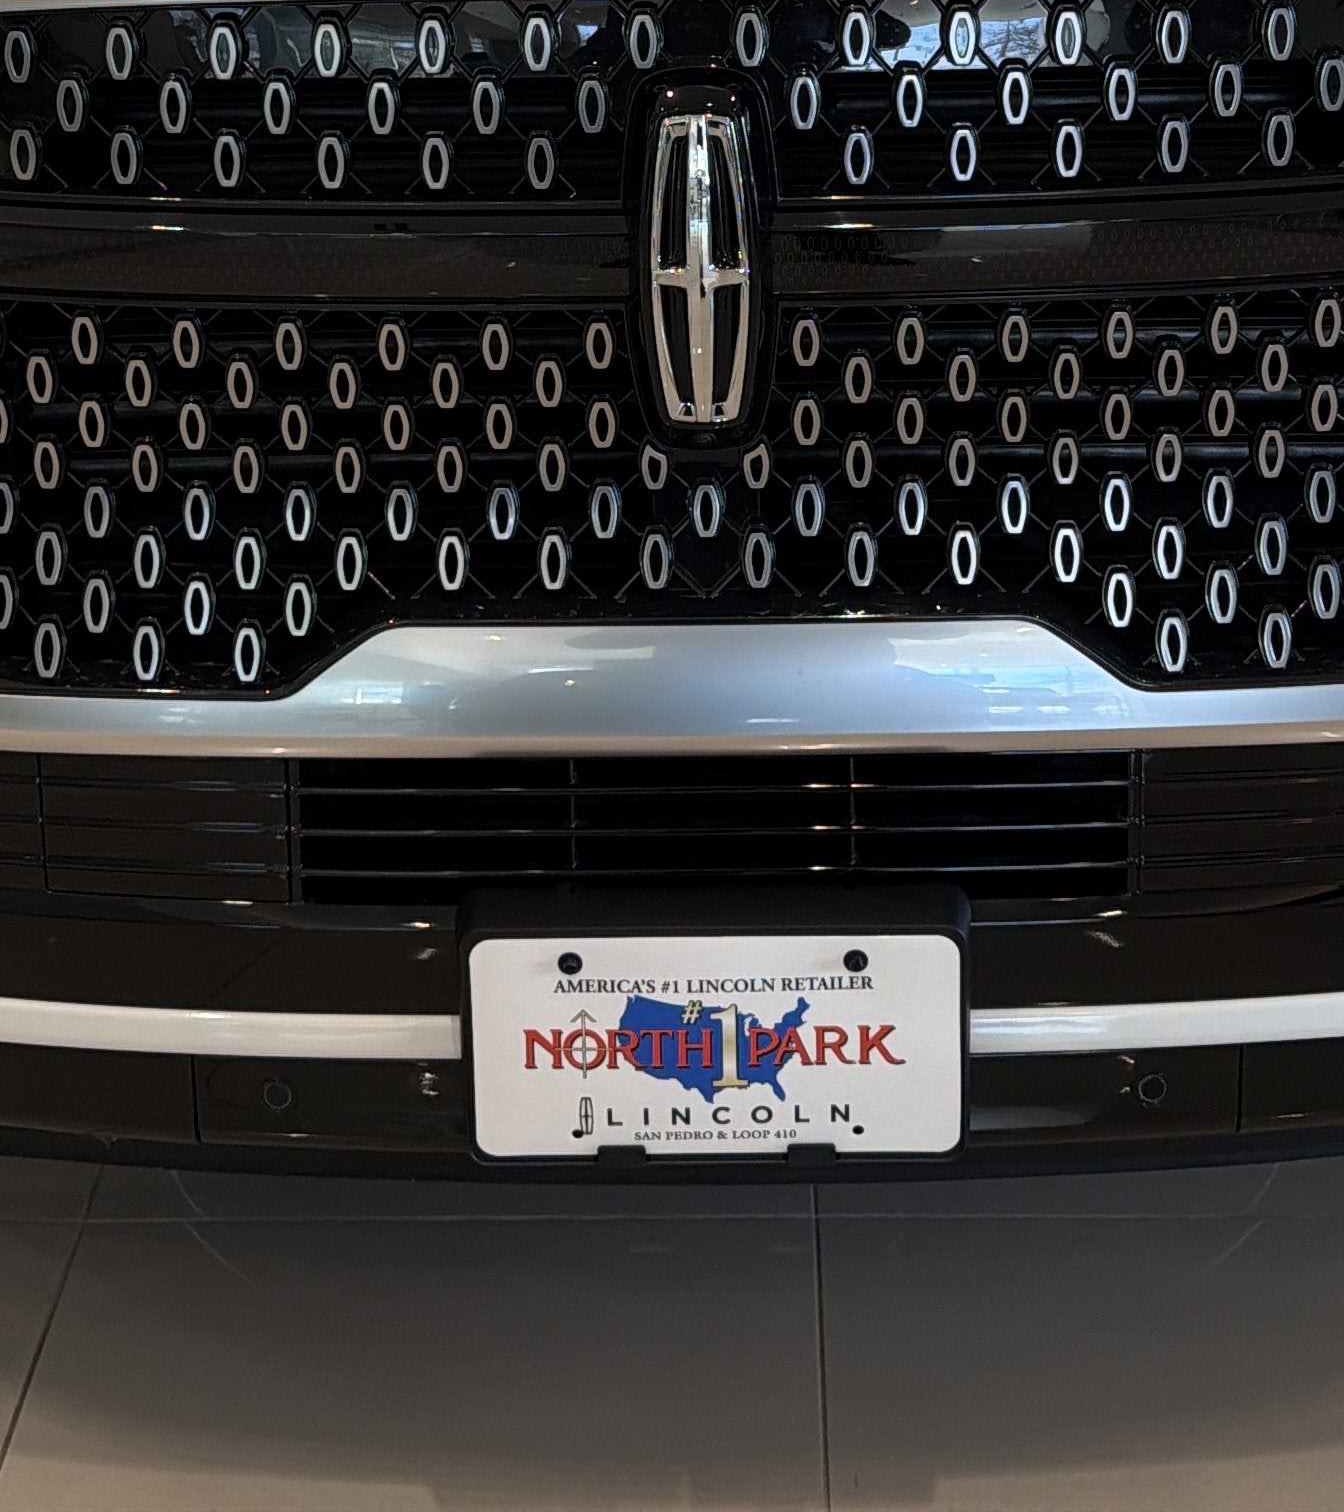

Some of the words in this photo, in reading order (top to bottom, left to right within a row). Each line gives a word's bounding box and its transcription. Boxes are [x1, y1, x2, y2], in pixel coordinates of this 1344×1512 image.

[554, 979, 656, 994] AMERICA'S
[661, 980, 680, 993] #1
[687, 977, 776, 993] LINCOLN
[781, 975, 874, 991] RETAILER
[523, 1028, 714, 1070] NORTH
[748, 1024, 906, 1068] PARK
[607, 1104, 850, 1126] LINCOLN
[634, 1131, 661, 1141] SAN
[666, 1131, 713, 1140] PEDRO
[716, 1131, 728, 1139] &
[732, 1130, 770, 1140] LOOP
[774, 1129, 796, 1139] 410
